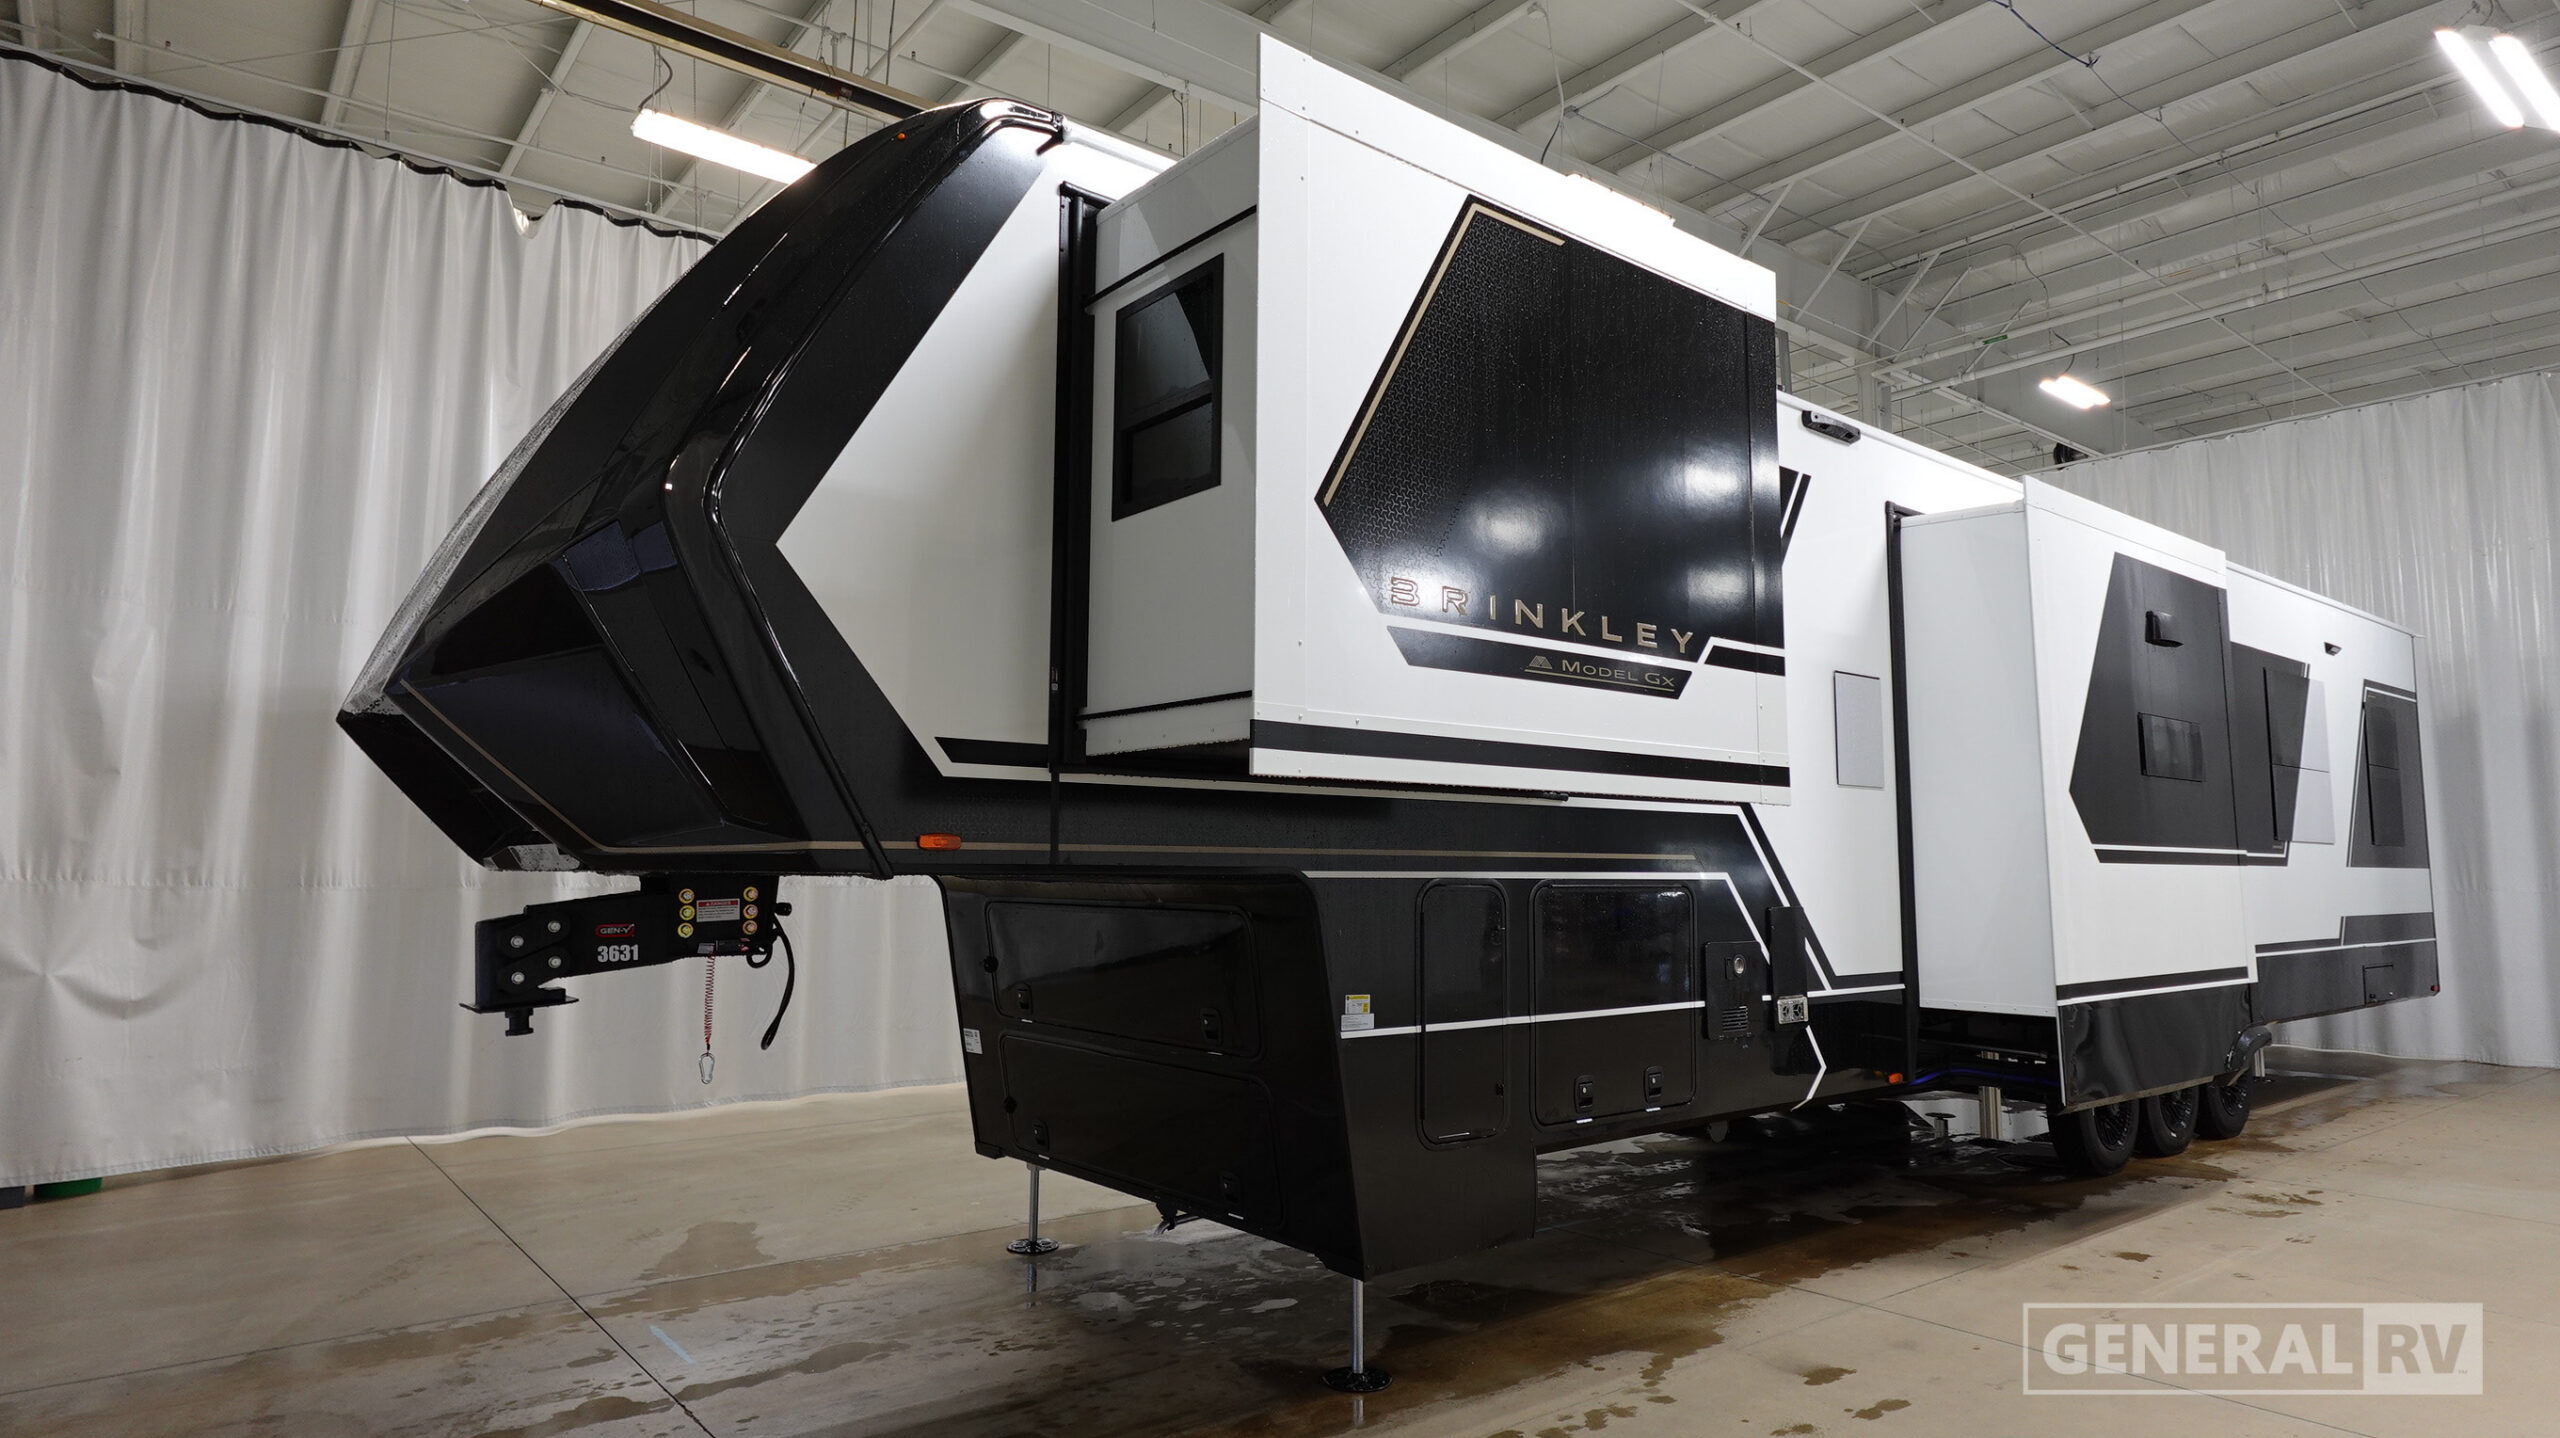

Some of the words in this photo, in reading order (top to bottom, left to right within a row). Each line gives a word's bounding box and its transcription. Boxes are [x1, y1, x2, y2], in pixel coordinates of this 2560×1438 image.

[1390, 576, 1694, 654] BRINKLEY
[600, 923, 635, 934] GEN-Y
[597, 944, 639, 962] 3631
